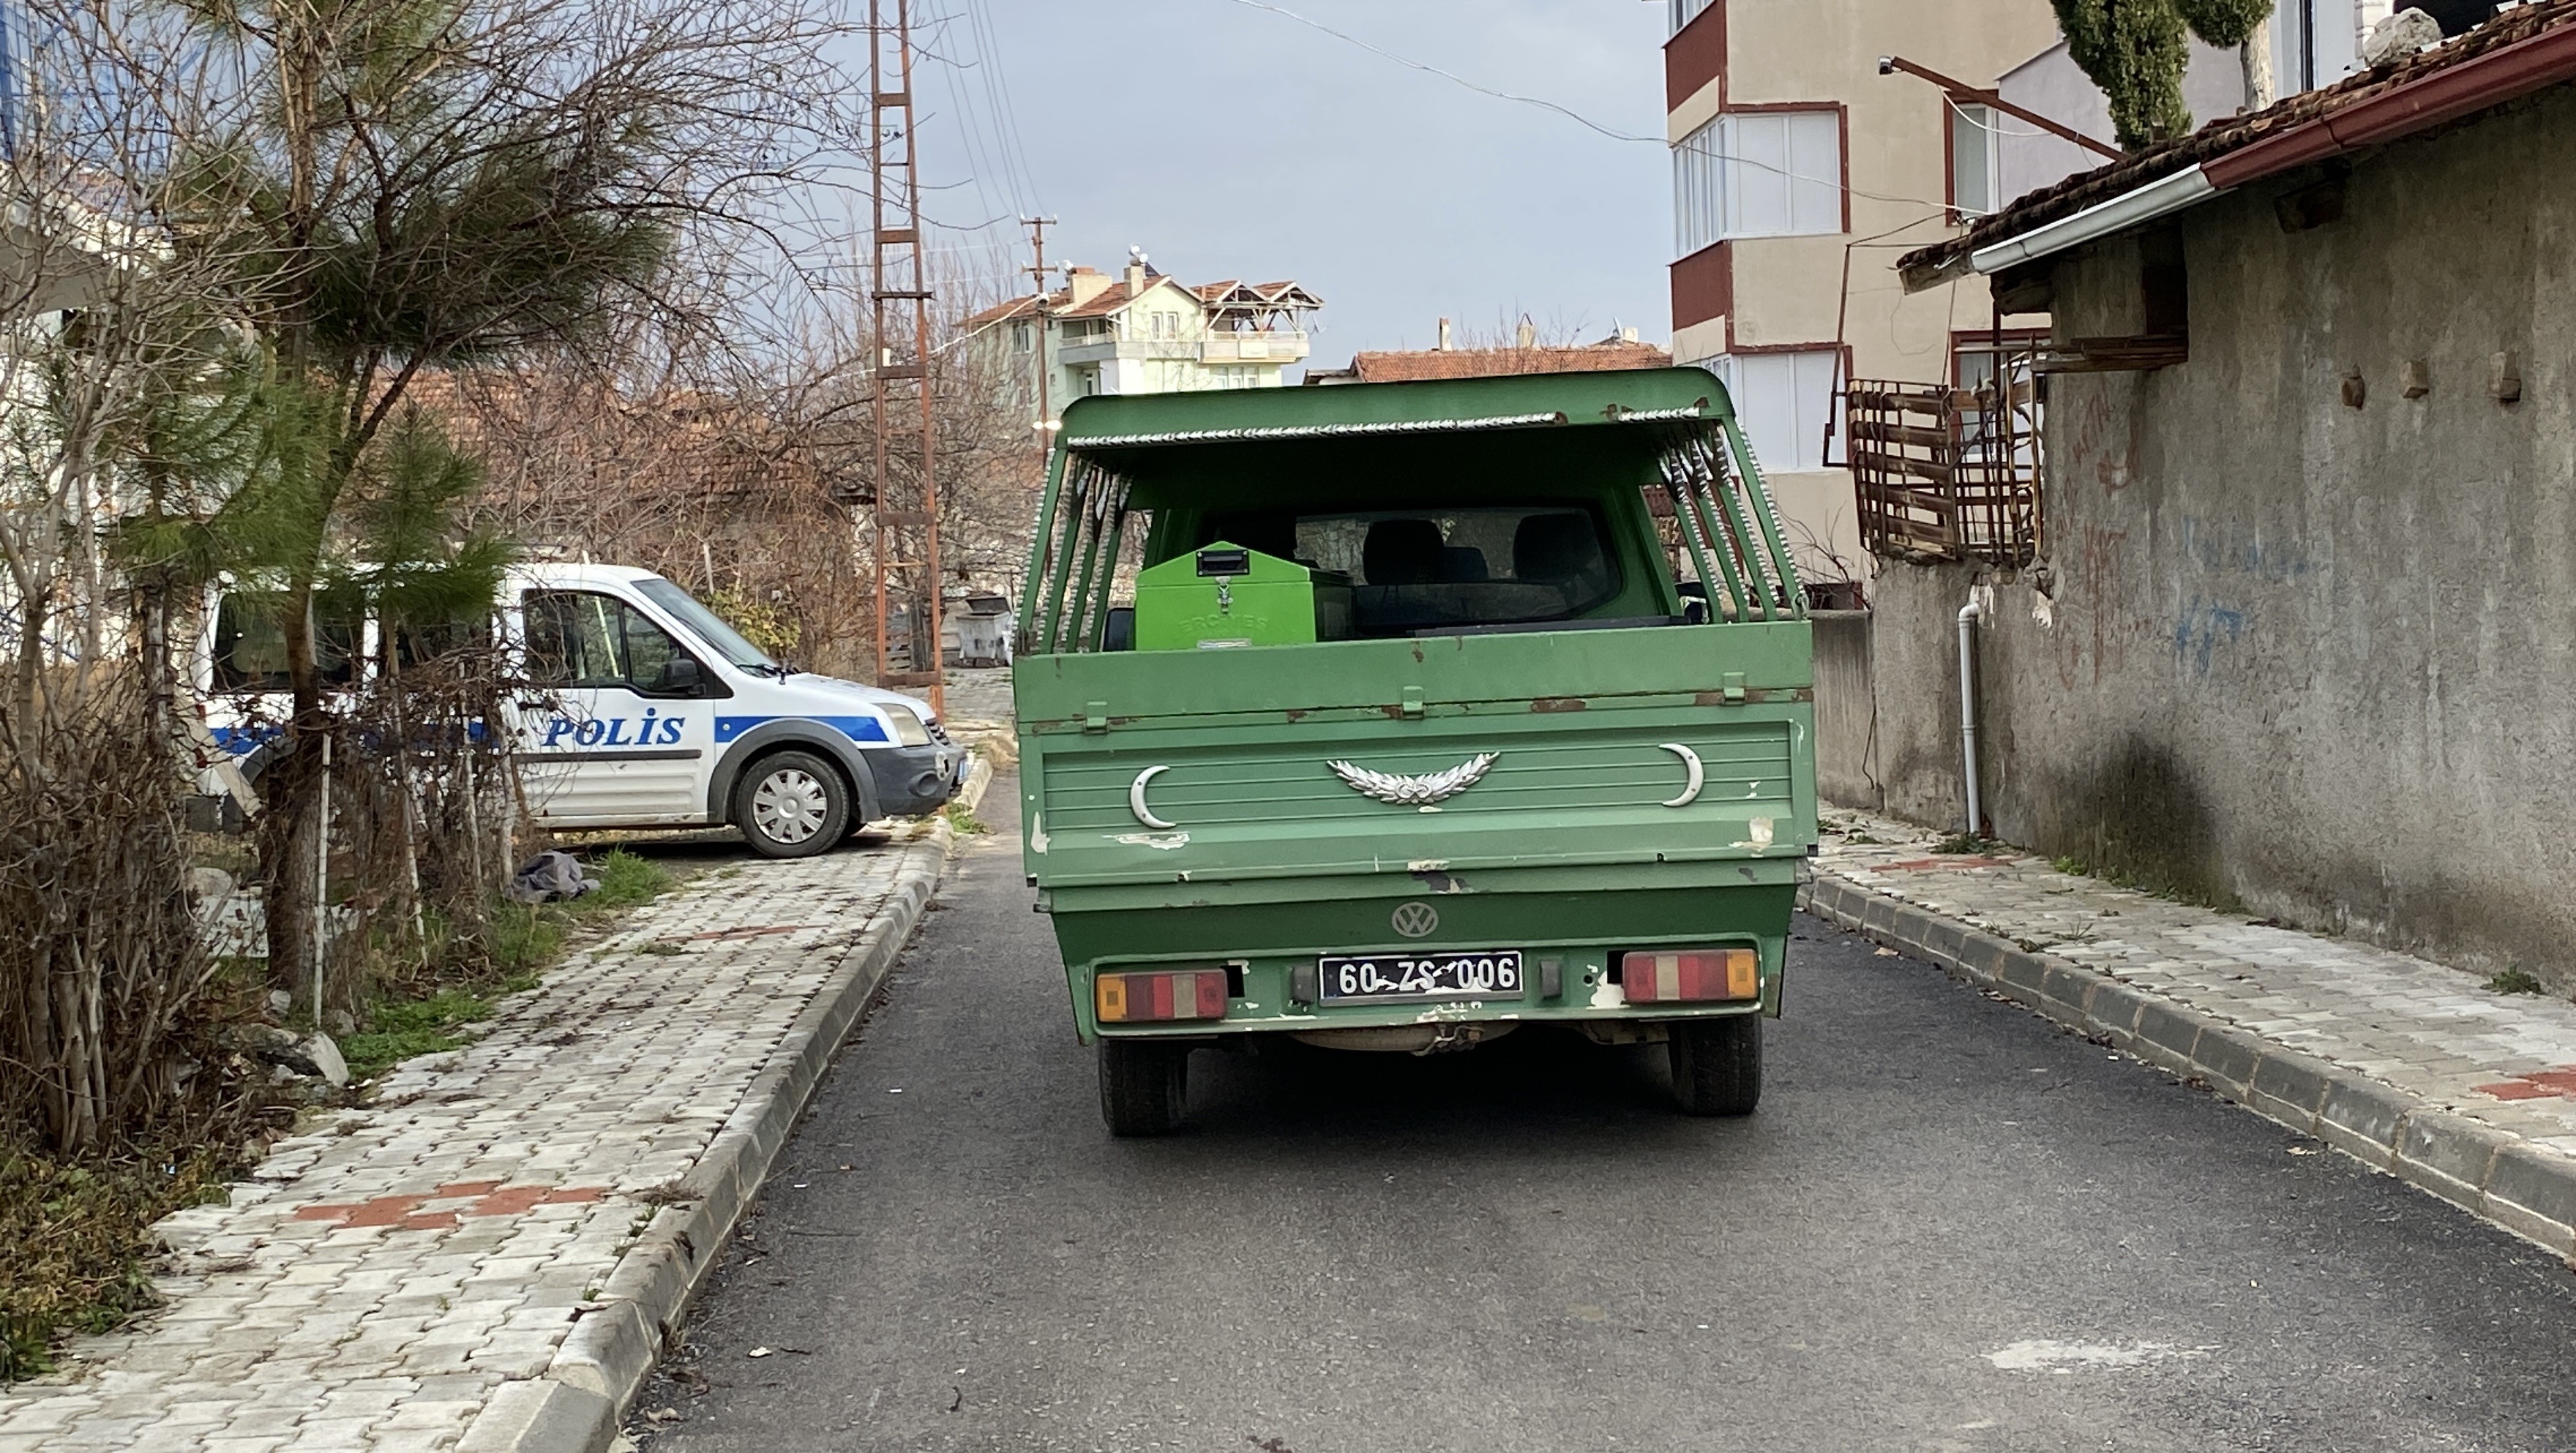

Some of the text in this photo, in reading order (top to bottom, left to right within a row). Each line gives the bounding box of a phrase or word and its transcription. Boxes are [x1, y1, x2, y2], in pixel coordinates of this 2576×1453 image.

[542, 707, 686, 746] POLİS
[1339, 958, 1516, 994] 60 ZS 006
